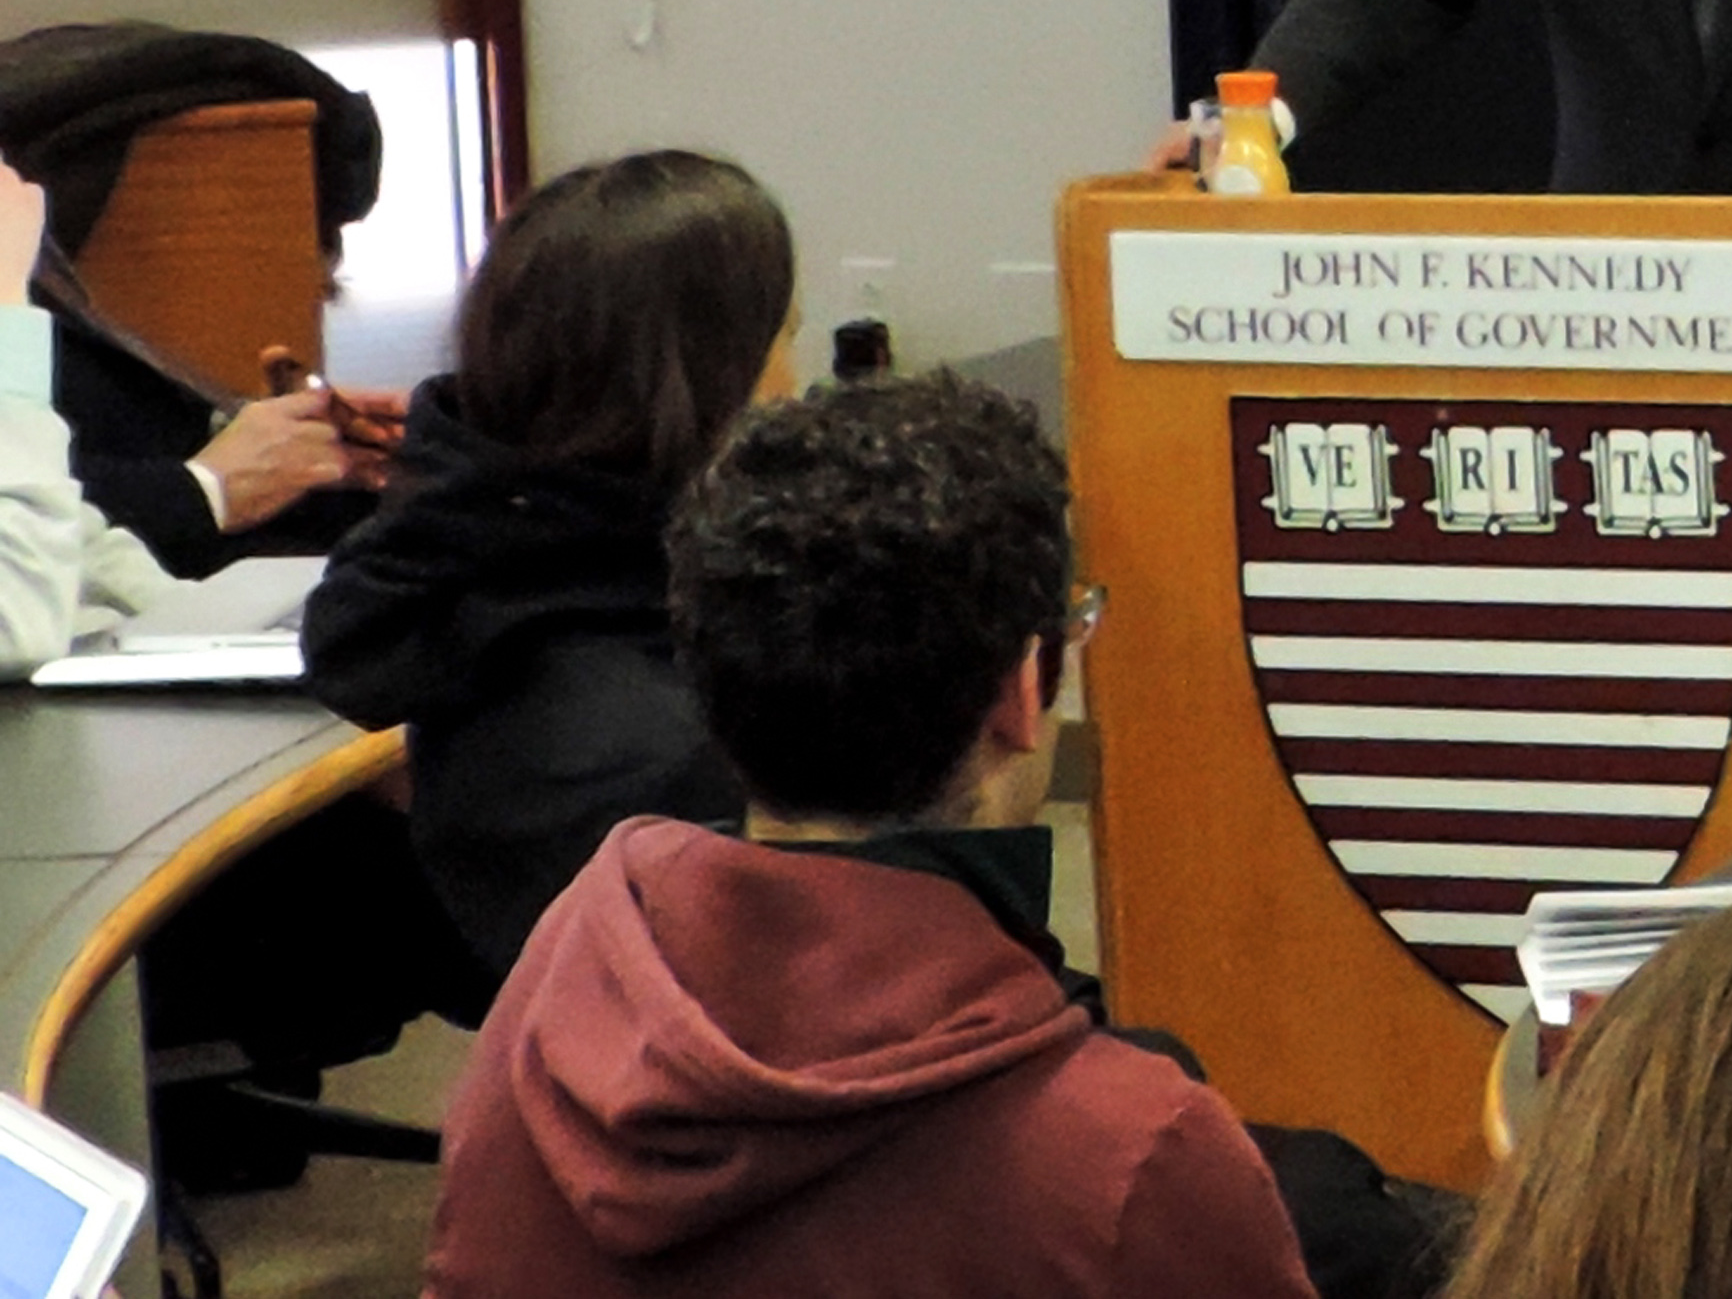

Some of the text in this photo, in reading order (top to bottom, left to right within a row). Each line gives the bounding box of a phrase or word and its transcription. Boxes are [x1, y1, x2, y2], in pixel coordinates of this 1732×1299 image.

[1273, 250, 1692, 298] JOHN F. KENNEDY
[1168, 306, 1350, 345] SCHOOL
[1377, 310, 1440, 346] OF
[1300, 444, 1357, 488] VE
[1614, 451, 1691, 496] TAS
